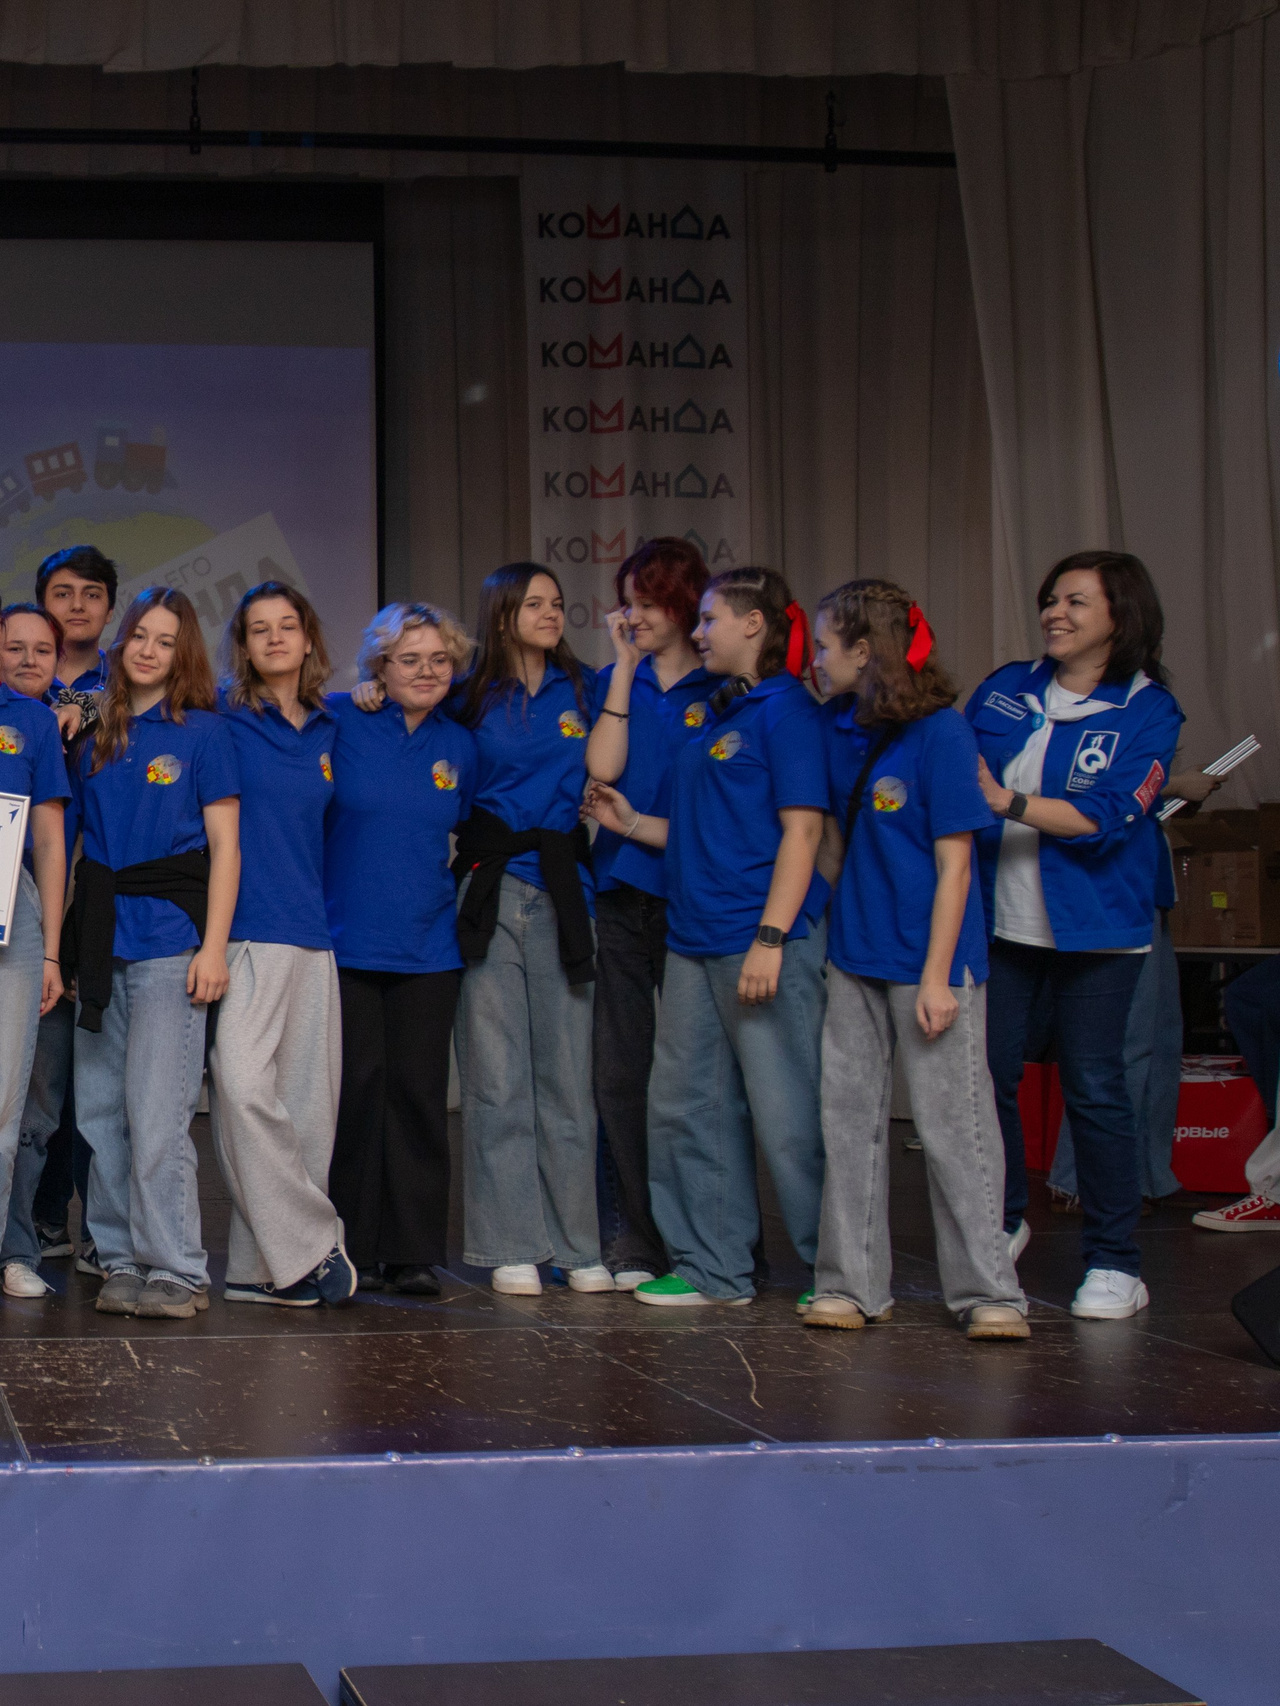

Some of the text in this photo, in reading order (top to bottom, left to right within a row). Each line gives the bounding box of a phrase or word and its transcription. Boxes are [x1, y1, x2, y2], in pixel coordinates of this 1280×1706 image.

[538, 203, 732, 240] КОМАНДА
[540, 267, 732, 304] КОМАНДА
[541, 332, 733, 369] КОМАНДА
[543, 397, 734, 434] КОМАНДА
[544, 462, 735, 499] КОМАНДА
[1173, 1126, 1230, 1142] рвые
